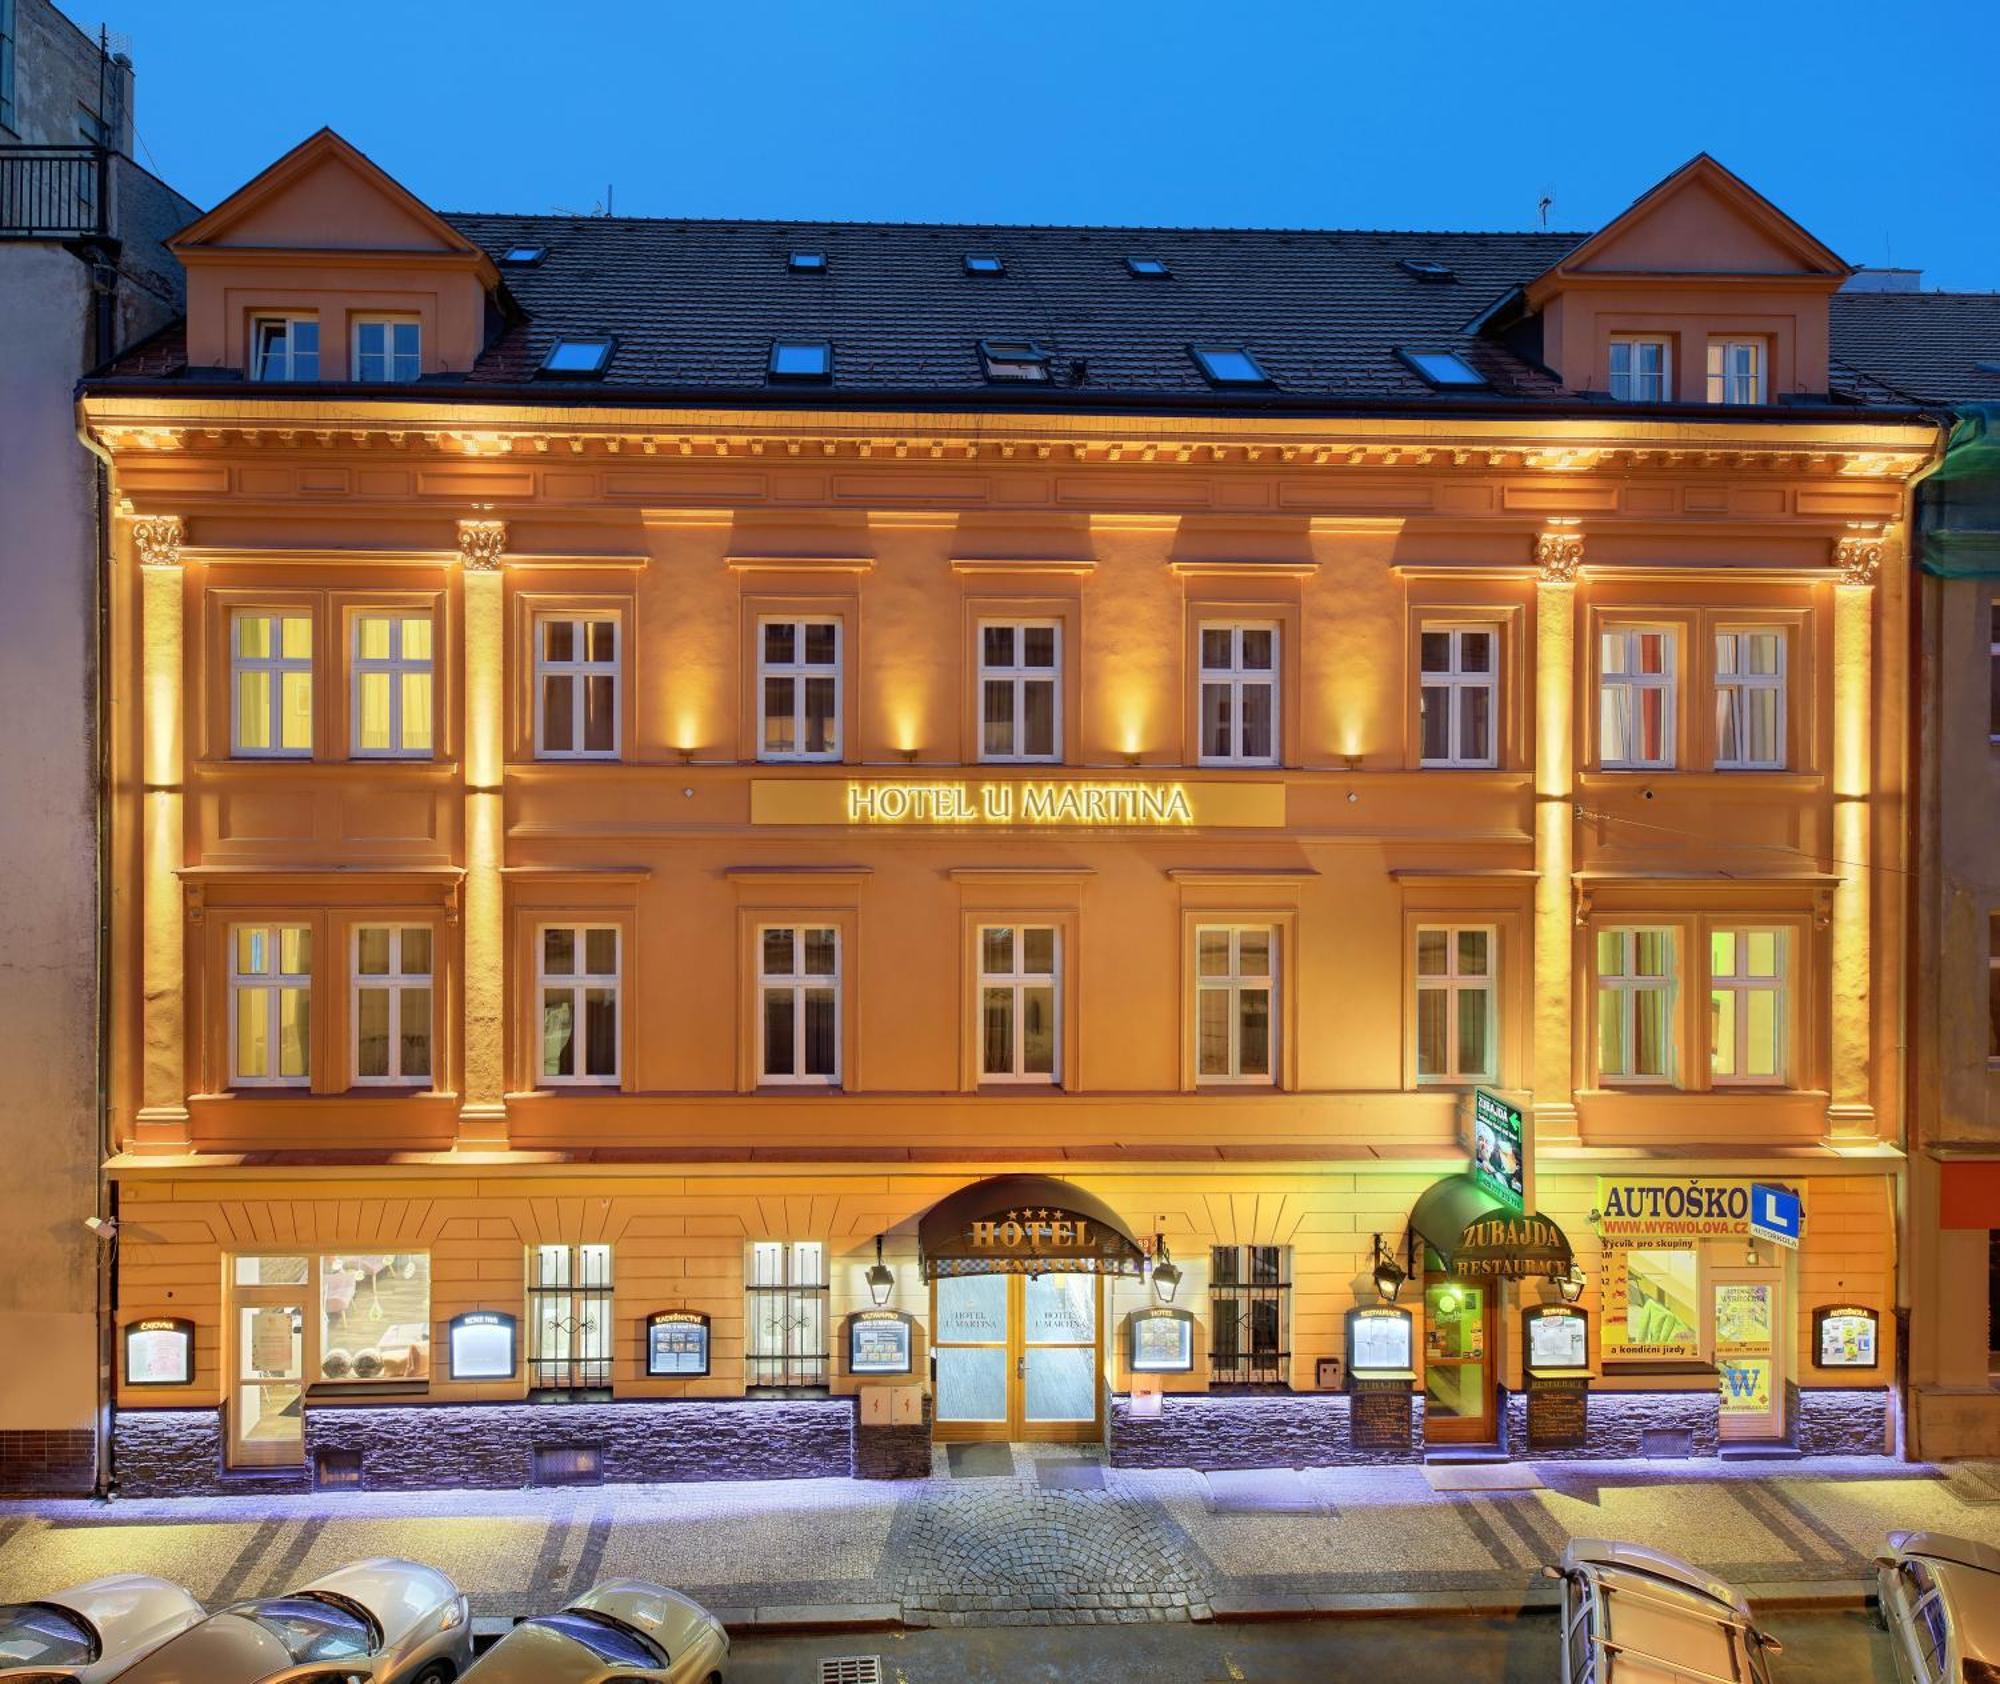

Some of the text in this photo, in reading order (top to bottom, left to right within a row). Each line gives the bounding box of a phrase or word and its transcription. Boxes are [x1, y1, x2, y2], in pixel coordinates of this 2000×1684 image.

[850, 788, 1191, 818] HOTEL U MARTINA
[1604, 1179, 1806, 1219] AUTOŠKO
[1766, 1193, 1788, 1228] L
[972, 1220, 1096, 1248] HOTEL
[1463, 1219, 1560, 1248] ZUBAJDA
[1604, 1220, 1749, 1234] WWW.WYRWOLOVA.CZ
[1753, 1226, 1797, 1248] AUTOŠKOLA
[1637, 1241, 1653, 1249] pro
[1656, 1240, 1693, 1249] skupiny
[1457, 1260, 1567, 1276] RESTAURACE
[955, 1311, 987, 1320] HOTEL
[1620, 1345, 1660, 1354] kondiční
[1727, 1369, 1760, 1397] W
